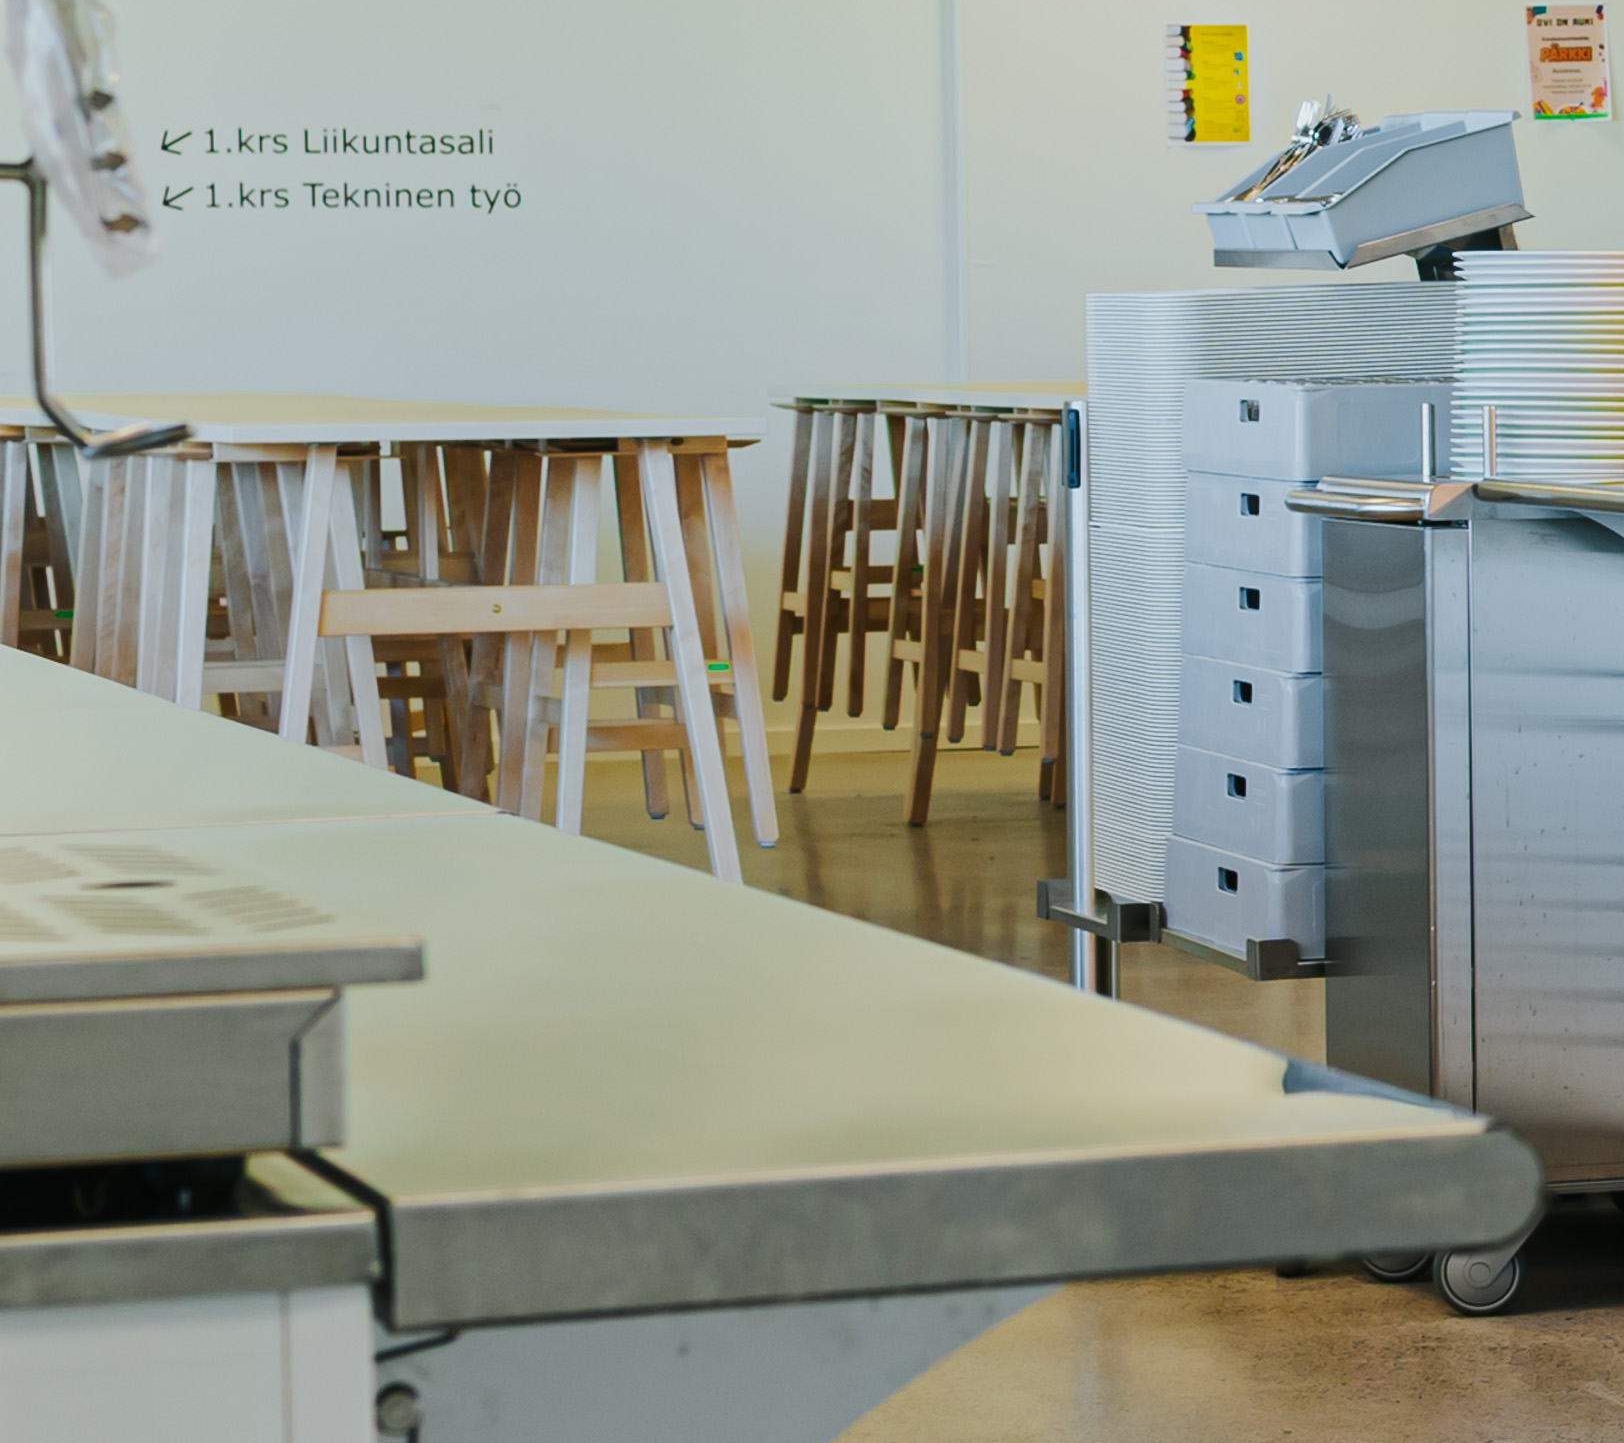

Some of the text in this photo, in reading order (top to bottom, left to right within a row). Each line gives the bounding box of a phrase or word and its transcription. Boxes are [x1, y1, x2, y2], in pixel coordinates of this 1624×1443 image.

[1540, 43, 1593, 62] PÄRKKI
[204, 128, 494, 155] 1.krs Liikuntasali
[205, 182, 522, 214] 1.krs Tekninen työ
